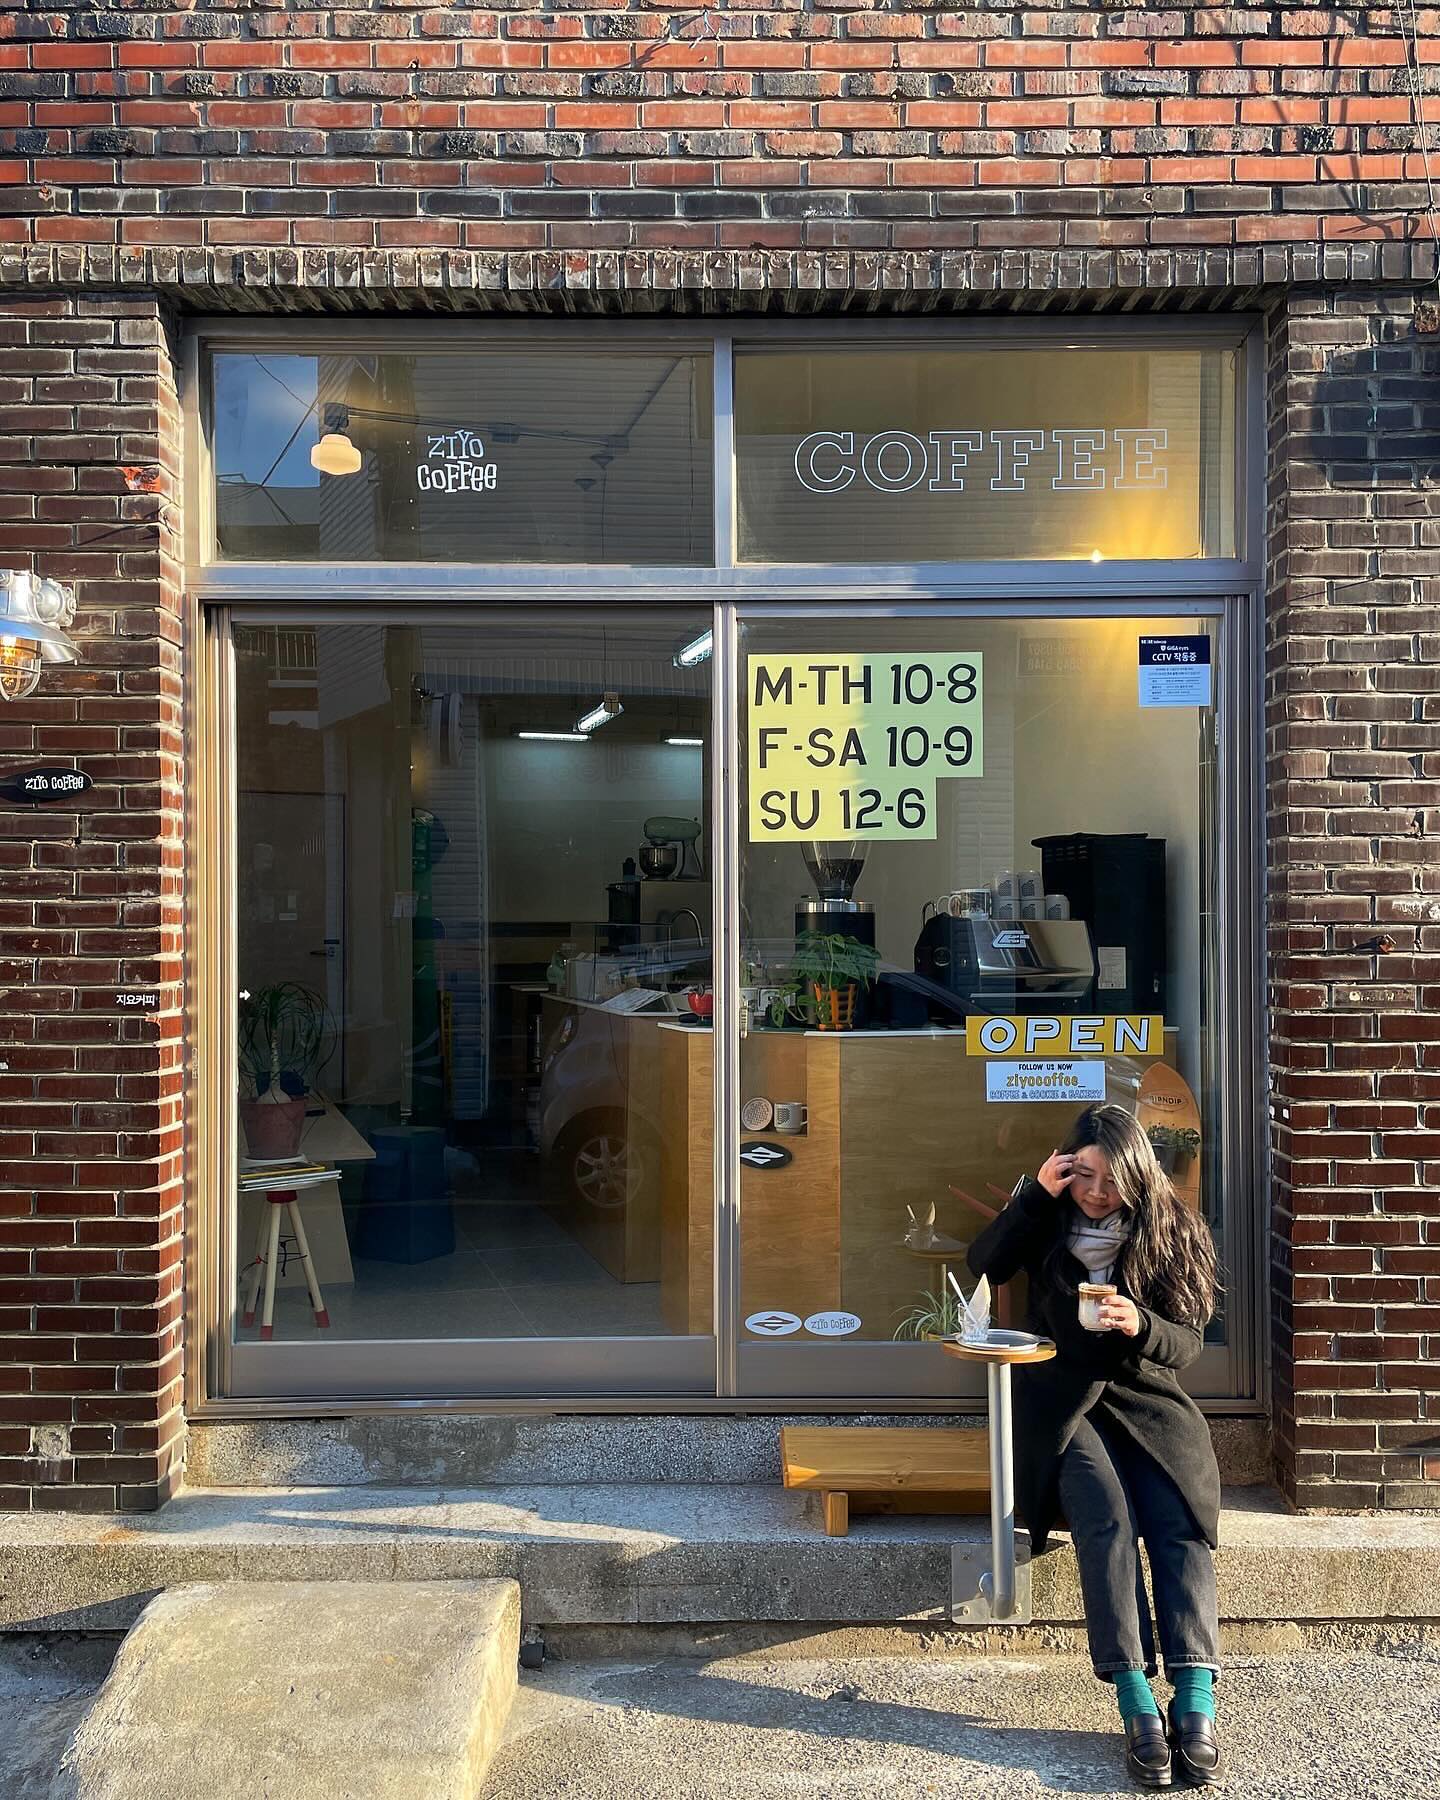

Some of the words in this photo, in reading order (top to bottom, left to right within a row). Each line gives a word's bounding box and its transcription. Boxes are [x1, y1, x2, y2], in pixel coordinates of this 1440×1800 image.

[794, 428, 1169, 493] COFFEE
[1152, 653, 1172, 662] CCTV
[1173, 651, 1197, 662] 작동중
[754, 664, 872, 707] M-TH
[890, 663, 978, 705] 10-8
[758, 727, 868, 769] F-SA
[886, 725, 974, 768] 10-9
[759, 789, 820, 831] SU
[839, 787, 927, 831] 12-6
[116, 994, 155, 1006] 지요커피
[979, 1017, 1151, 1053] OPEN
[1018, 1063, 1043, 1071] FOLLOW
[1046, 1063, 1054, 1071] US
[1057, 1063, 1073, 1071] NOW
